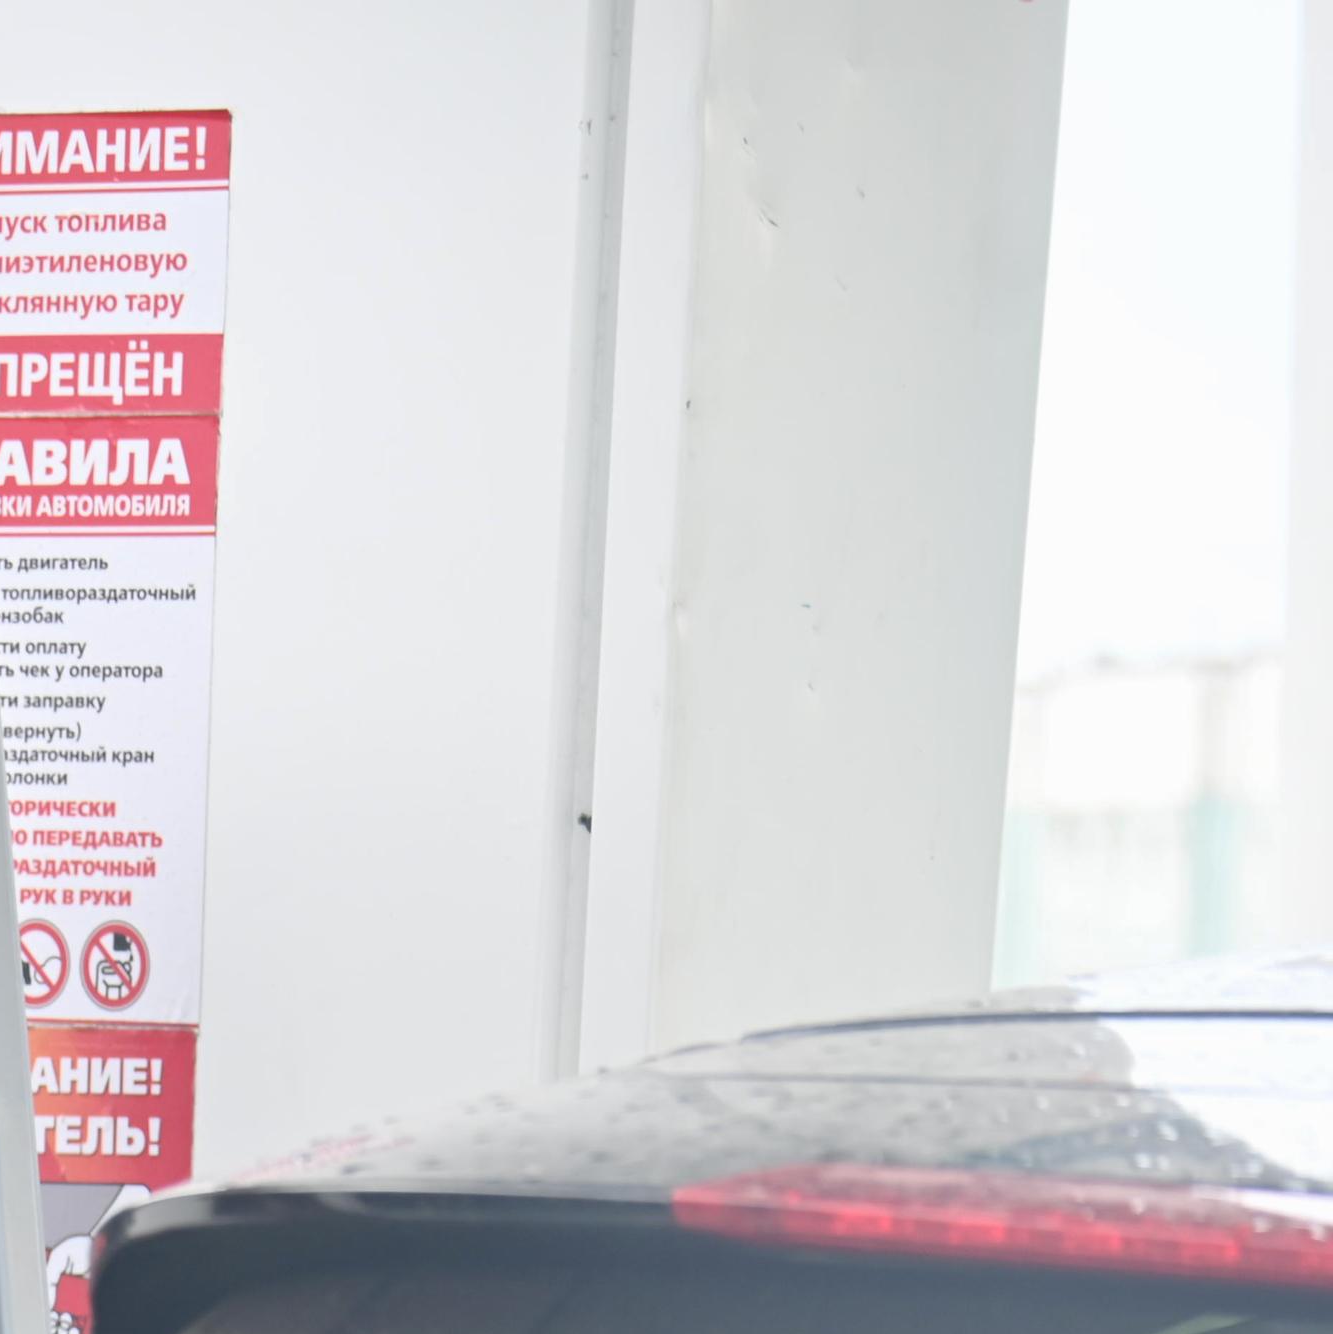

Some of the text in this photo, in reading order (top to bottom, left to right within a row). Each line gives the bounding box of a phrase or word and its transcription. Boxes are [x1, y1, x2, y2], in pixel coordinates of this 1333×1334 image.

[55, 212, 167, 234] топлива
[125, 293, 185, 319] тару
[36, 494, 191, 517] АВТОМОБИЛЯ
[17, 556, 108, 572] двигатель
[1, 584, 196, 604] топливораздаточный
[25, 641, 87, 658] оплату
[20, 665, 50, 677] чек
[55, 665, 65, 682] у
[69, 665, 164, 682] оператора
[23, 695, 107, 713] заправку
[111, 750, 155, 767] кран
[9, 800, 116, 817] ОРИЧЕСКИ
[33, 829, 164, 850] ПЕРЕДАВАТЬ
[20, 889, 132, 906] РУК В РУКИ
[31, 1056, 163, 1096] АНИЕ!
